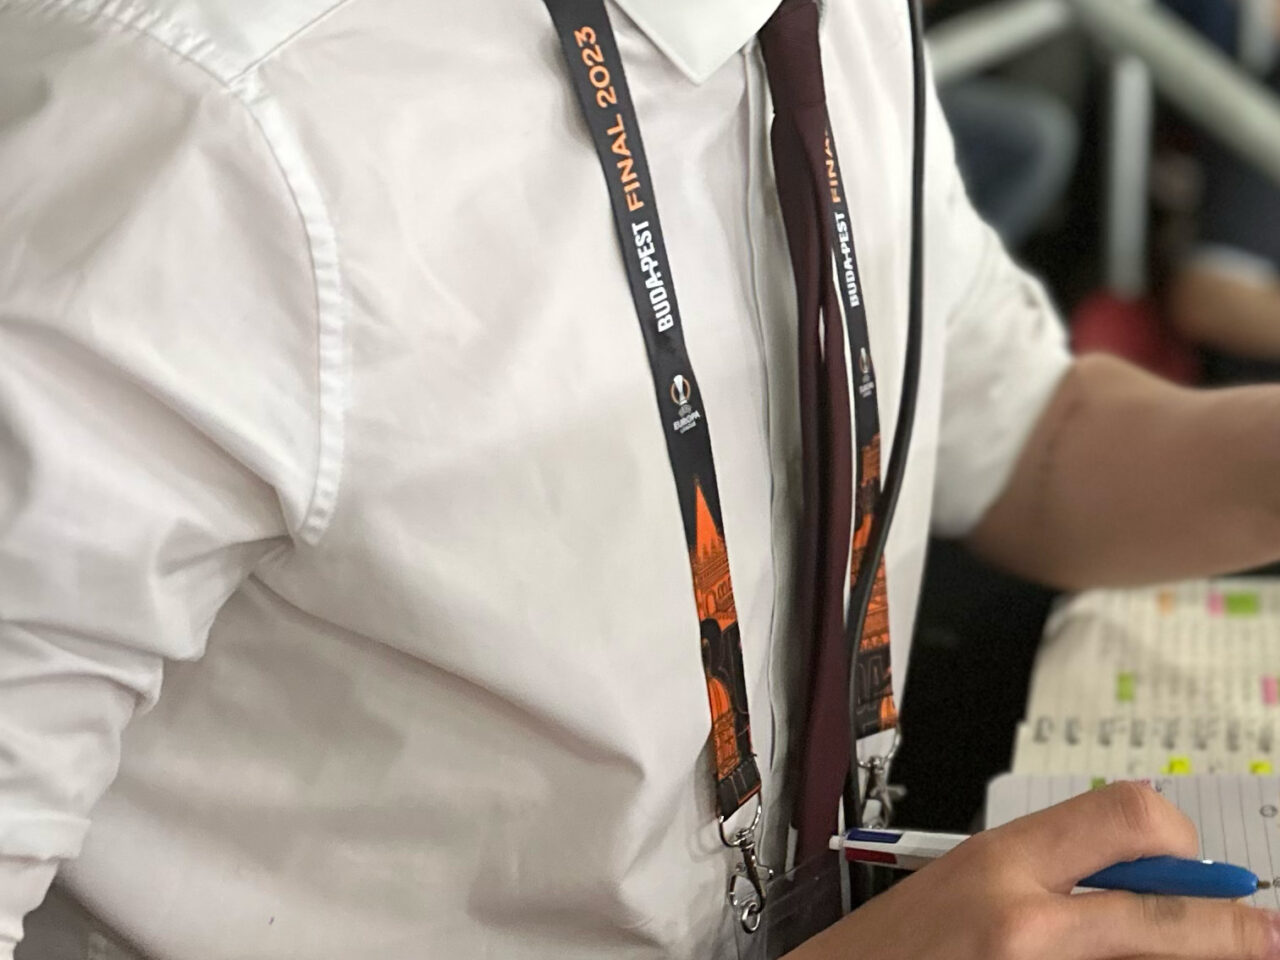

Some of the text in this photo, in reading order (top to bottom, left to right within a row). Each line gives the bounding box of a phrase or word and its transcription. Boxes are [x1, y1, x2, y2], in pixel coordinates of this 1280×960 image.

[573, 25, 617, 109] 2023
[606, 113, 645, 212] FINAL
[673, 410, 700, 431] EUROPA
